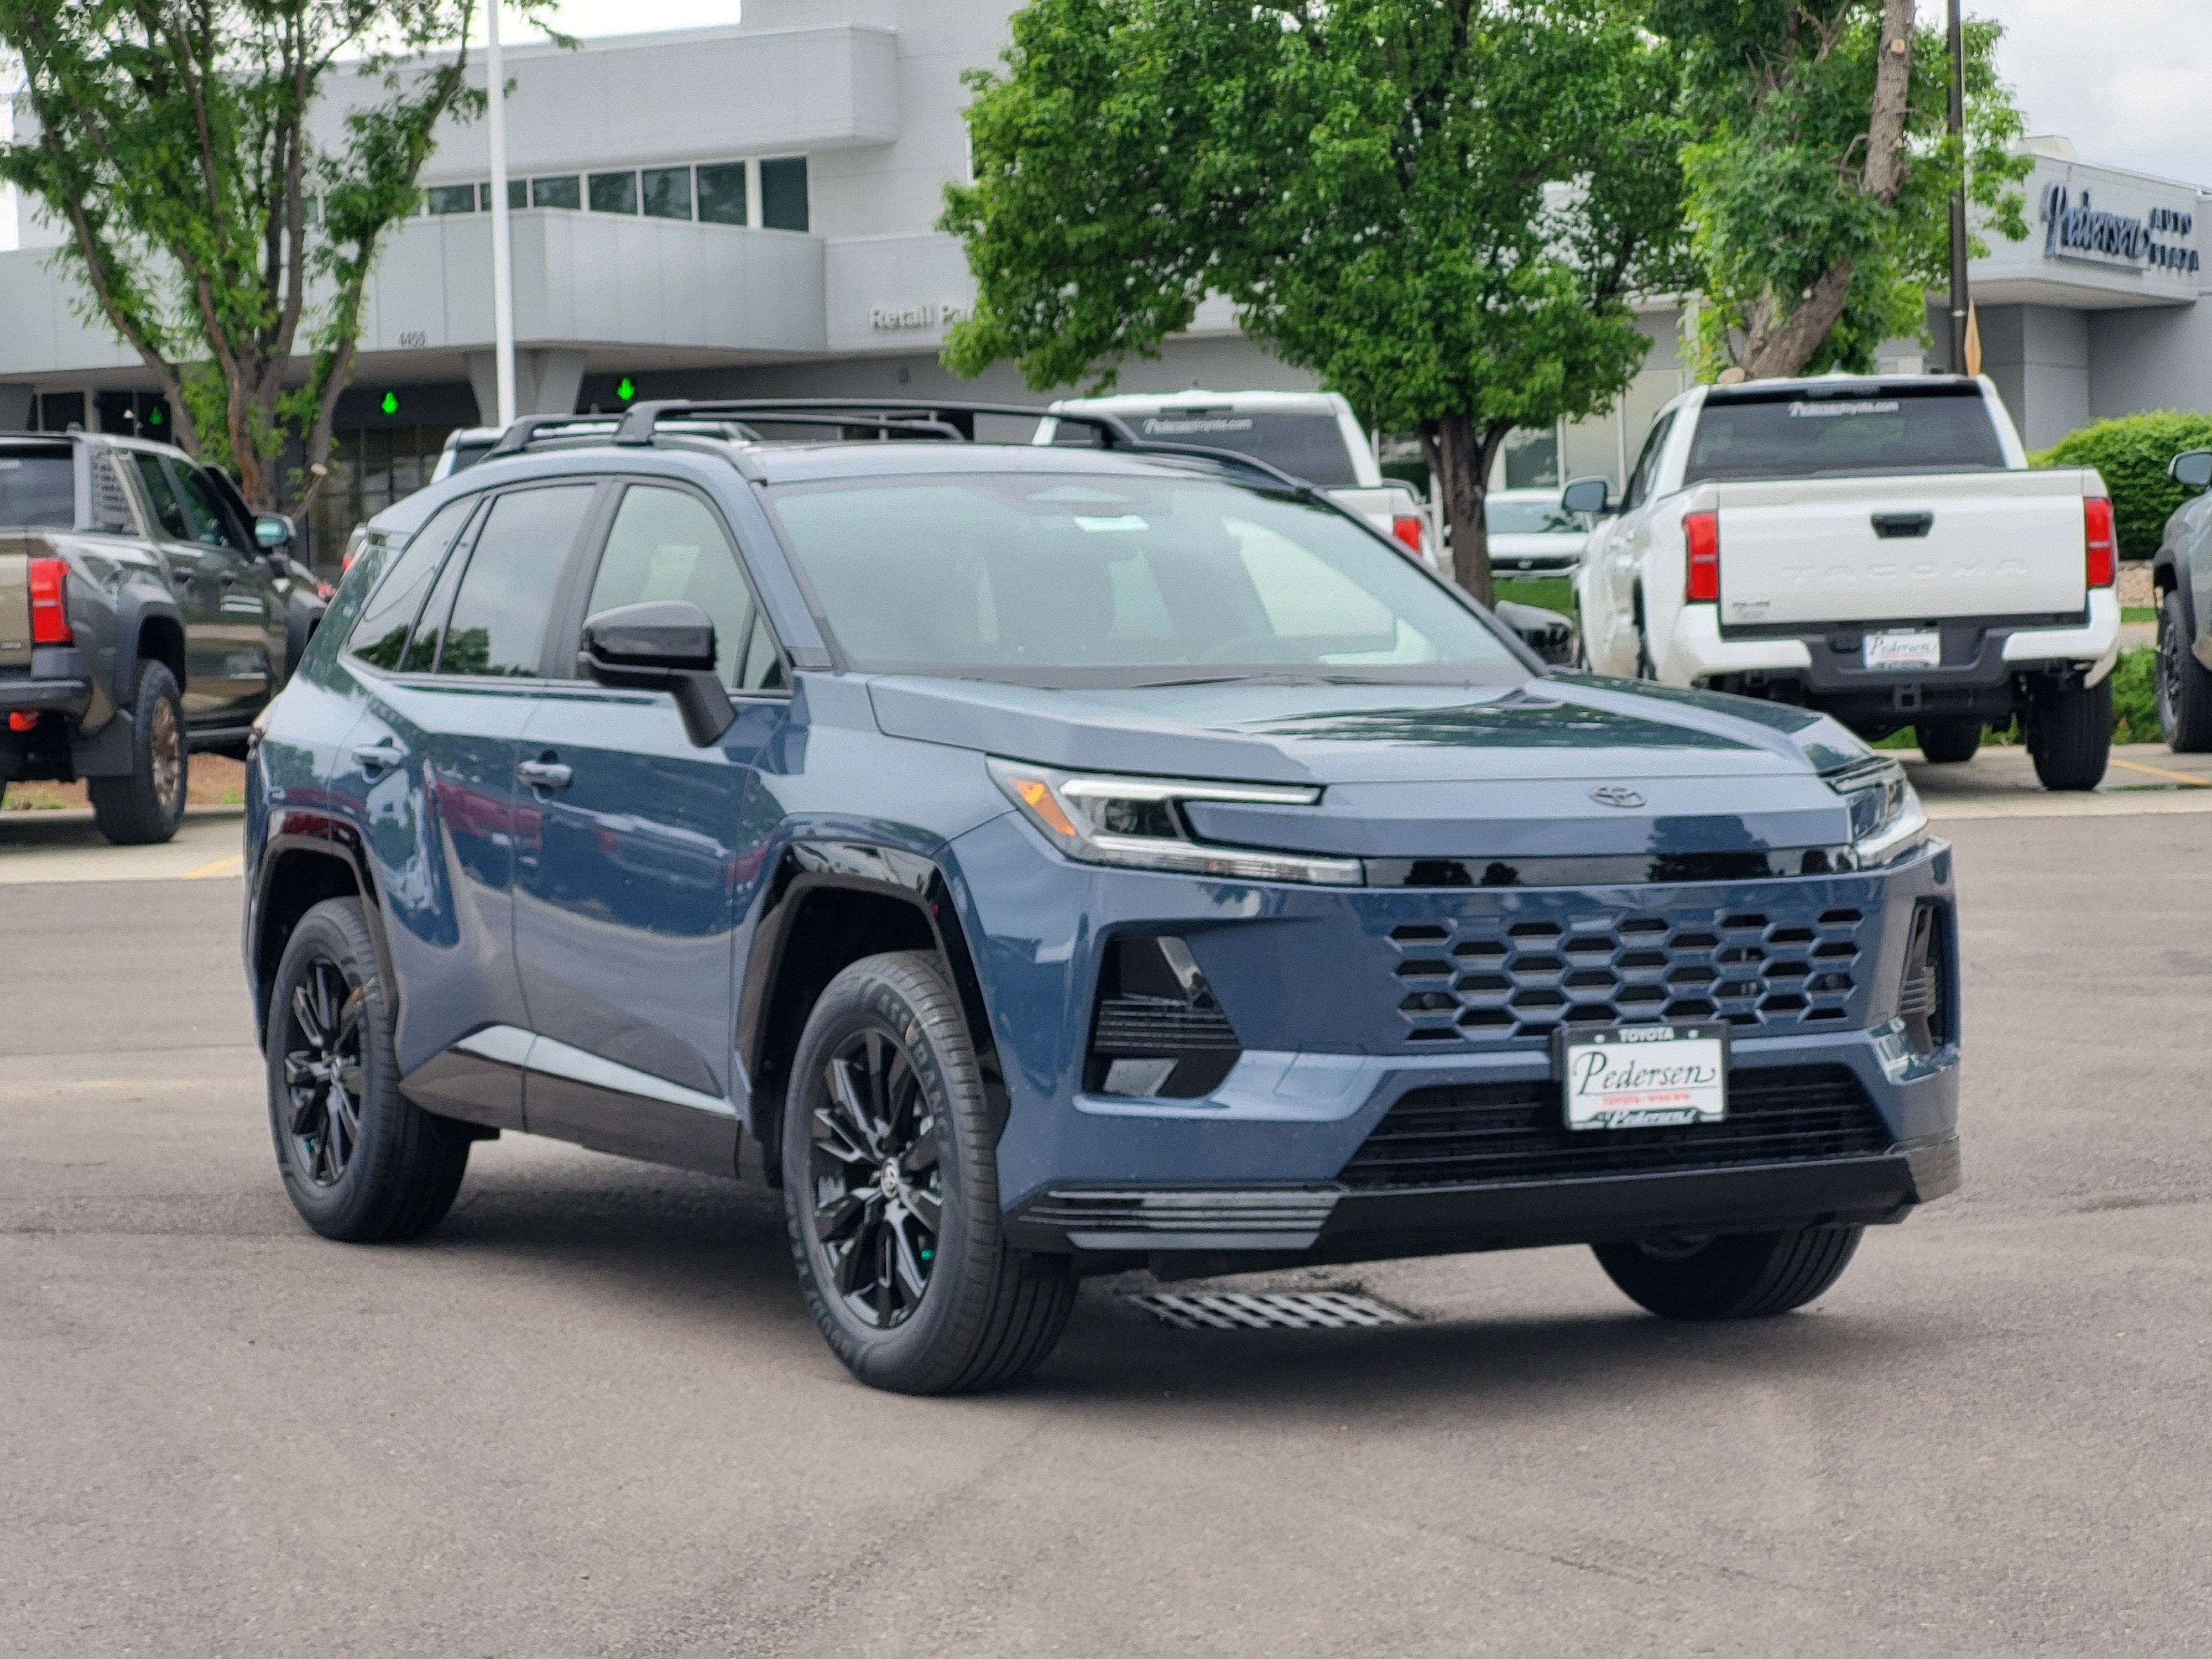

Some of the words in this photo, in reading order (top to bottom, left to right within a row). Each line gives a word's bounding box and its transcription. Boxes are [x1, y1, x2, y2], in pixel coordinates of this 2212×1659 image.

[1780, 559, 2027, 583] TACOMA
[1619, 1027, 1674, 1043] TOYOTA
[1574, 1051, 1715, 1095] Pedersen
